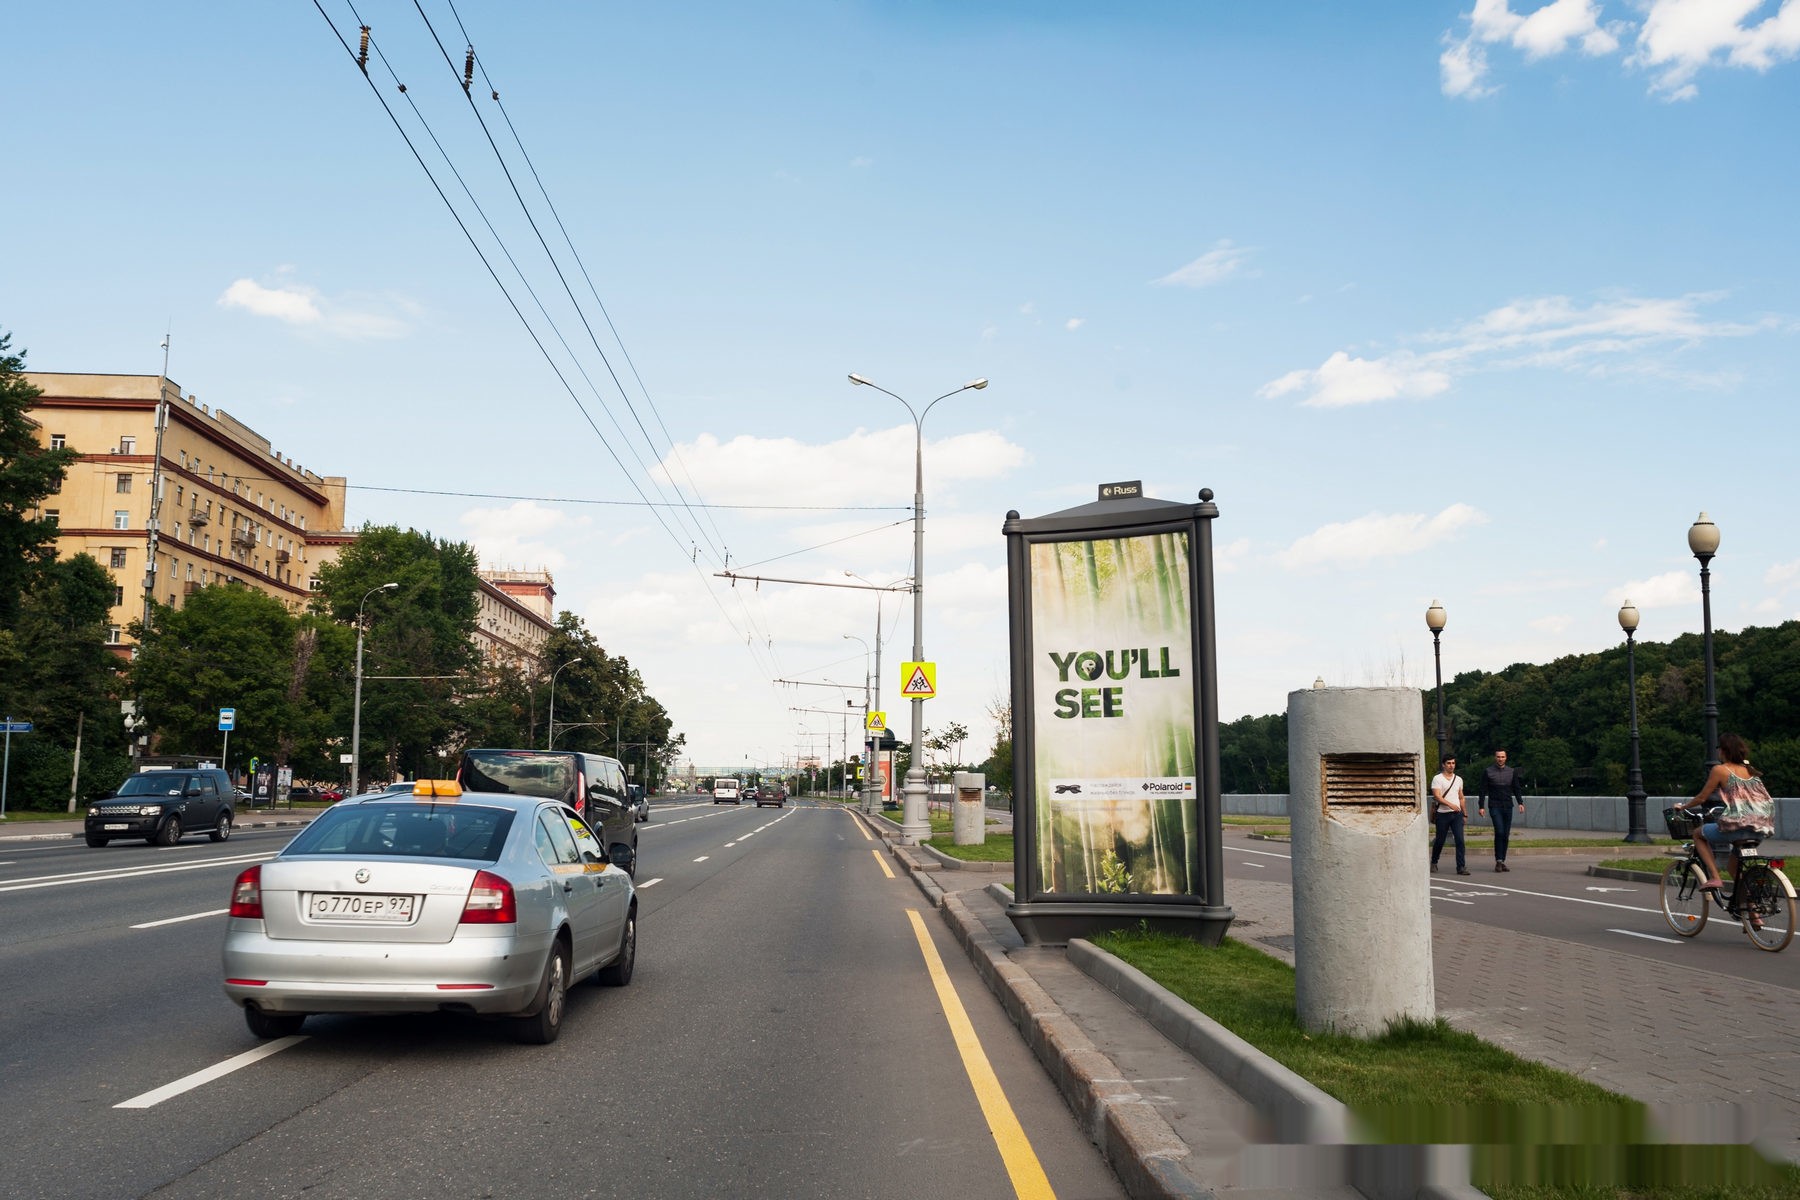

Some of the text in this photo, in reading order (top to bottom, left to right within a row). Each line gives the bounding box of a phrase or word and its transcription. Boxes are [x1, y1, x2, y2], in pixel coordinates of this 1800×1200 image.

[1113, 486, 1138, 495] Russ
[1048, 646, 1181, 683] YOU'LL
[1054, 686, 1124, 719] SEE
[1149, 782, 1183, 791] Polaroid
[390, 898, 407, 910] 97
